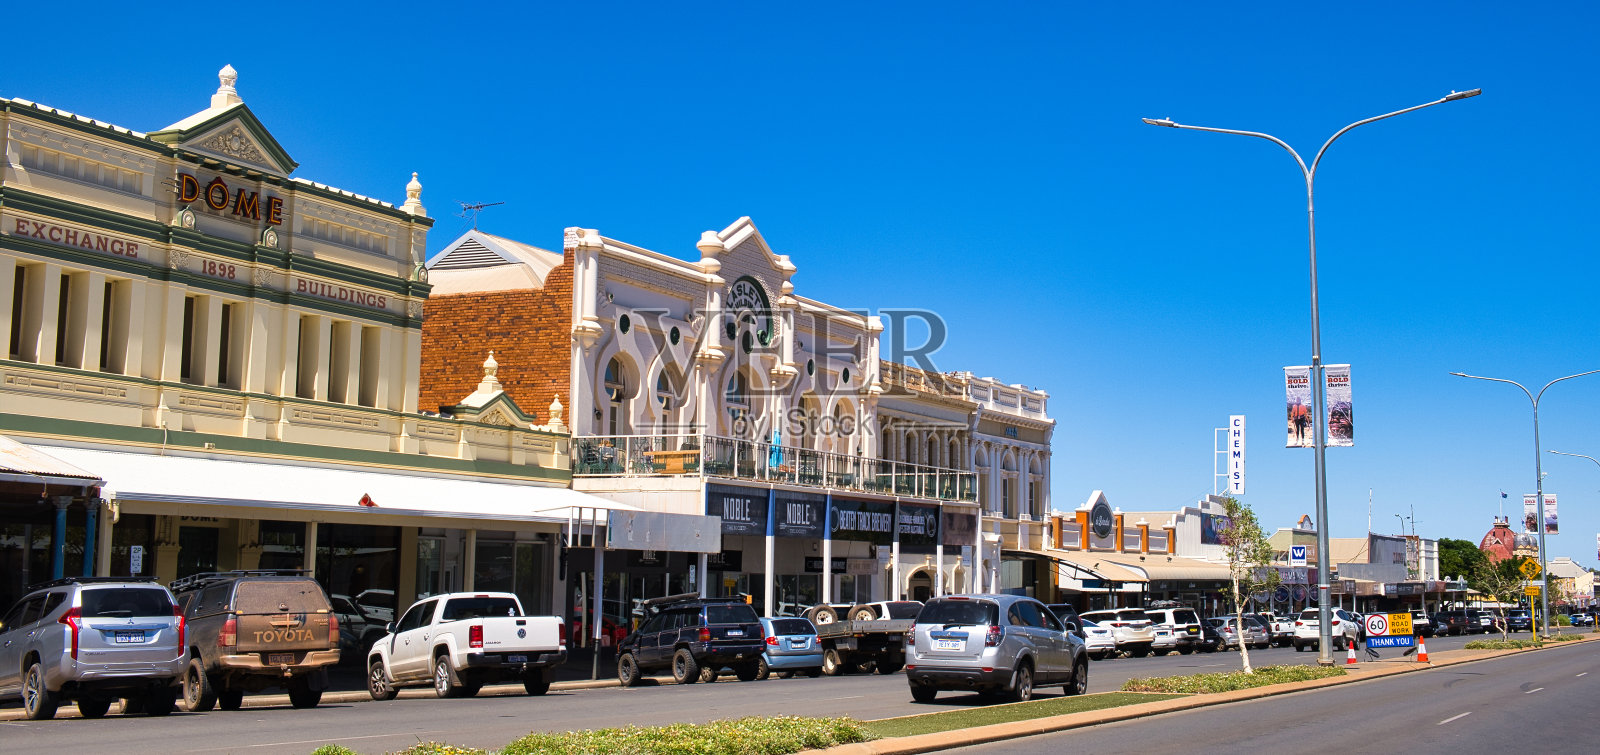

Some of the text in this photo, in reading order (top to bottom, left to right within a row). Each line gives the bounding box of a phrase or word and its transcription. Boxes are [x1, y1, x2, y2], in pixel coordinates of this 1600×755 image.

[177, 172, 284, 226] DÔME
[15, 218, 139, 258] EXCHANGE
[201, 259, 236, 280] 1898
[296, 278, 387, 309] BUILDINGS
[1233, 419, 1241, 490] CHEMIST
[723, 497, 751, 521] NOBLE
[786, 503, 811, 525] NOBLE
[839, 510, 856, 530] BEATEN
[857, 511, 871, 531] TRACK
[1370, 620, 1384, 630] 60
[254, 630, 314, 643] TOYOTA
[1370, 637, 1410, 646] THANK YOU
